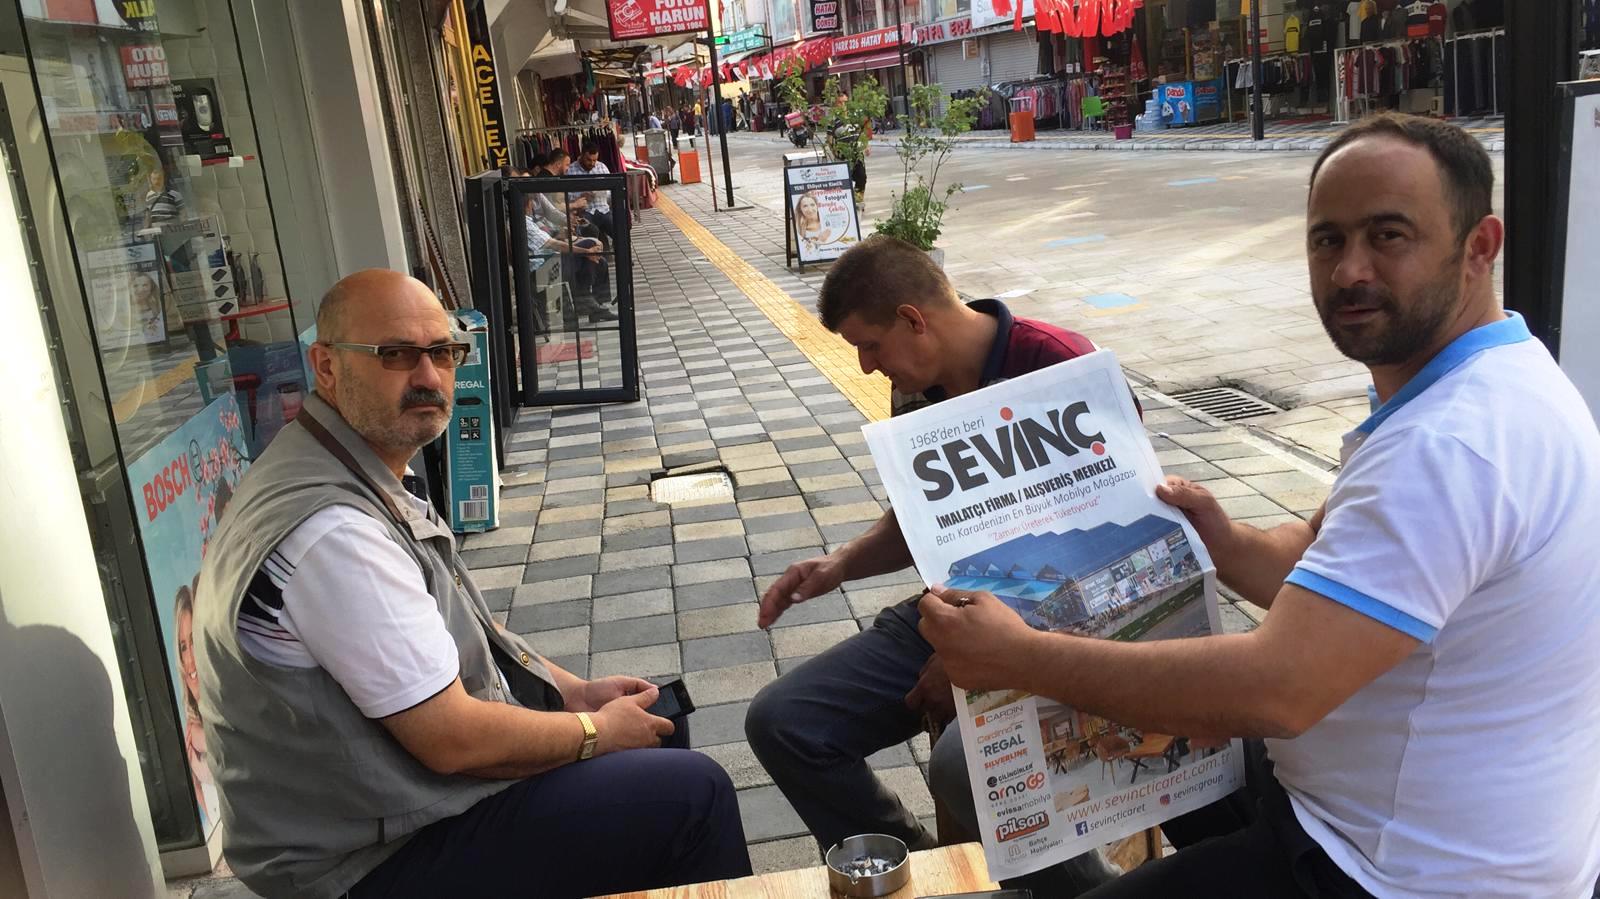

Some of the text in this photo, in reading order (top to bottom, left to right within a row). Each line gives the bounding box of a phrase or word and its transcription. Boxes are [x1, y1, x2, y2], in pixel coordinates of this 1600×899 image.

[649, 6, 705, 26] HARUN
[815, 2, 837, 16] HATAY
[861, 33, 882, 48] HATAY
[454, 380, 485, 389] REGAL
[910, 416, 985, 450] 1968'den beri
[912, 400, 1107, 502] SEVİNÇ
[142, 452, 193, 522] BOSCH
[935, 504, 985, 530] İMALATÇI
[984, 492, 1018, 513] FİRMA
[1023, 472, 1074, 500] ALIŞVERİŞ
[1071, 455, 1117, 483] MERKEZİ
[935, 469, 1137, 546] Batı Karadenizin En Büyük Mobilya Mağazası
[983, 734, 1025, 758] REGAL
[998, 811, 1045, 840] pilsan
